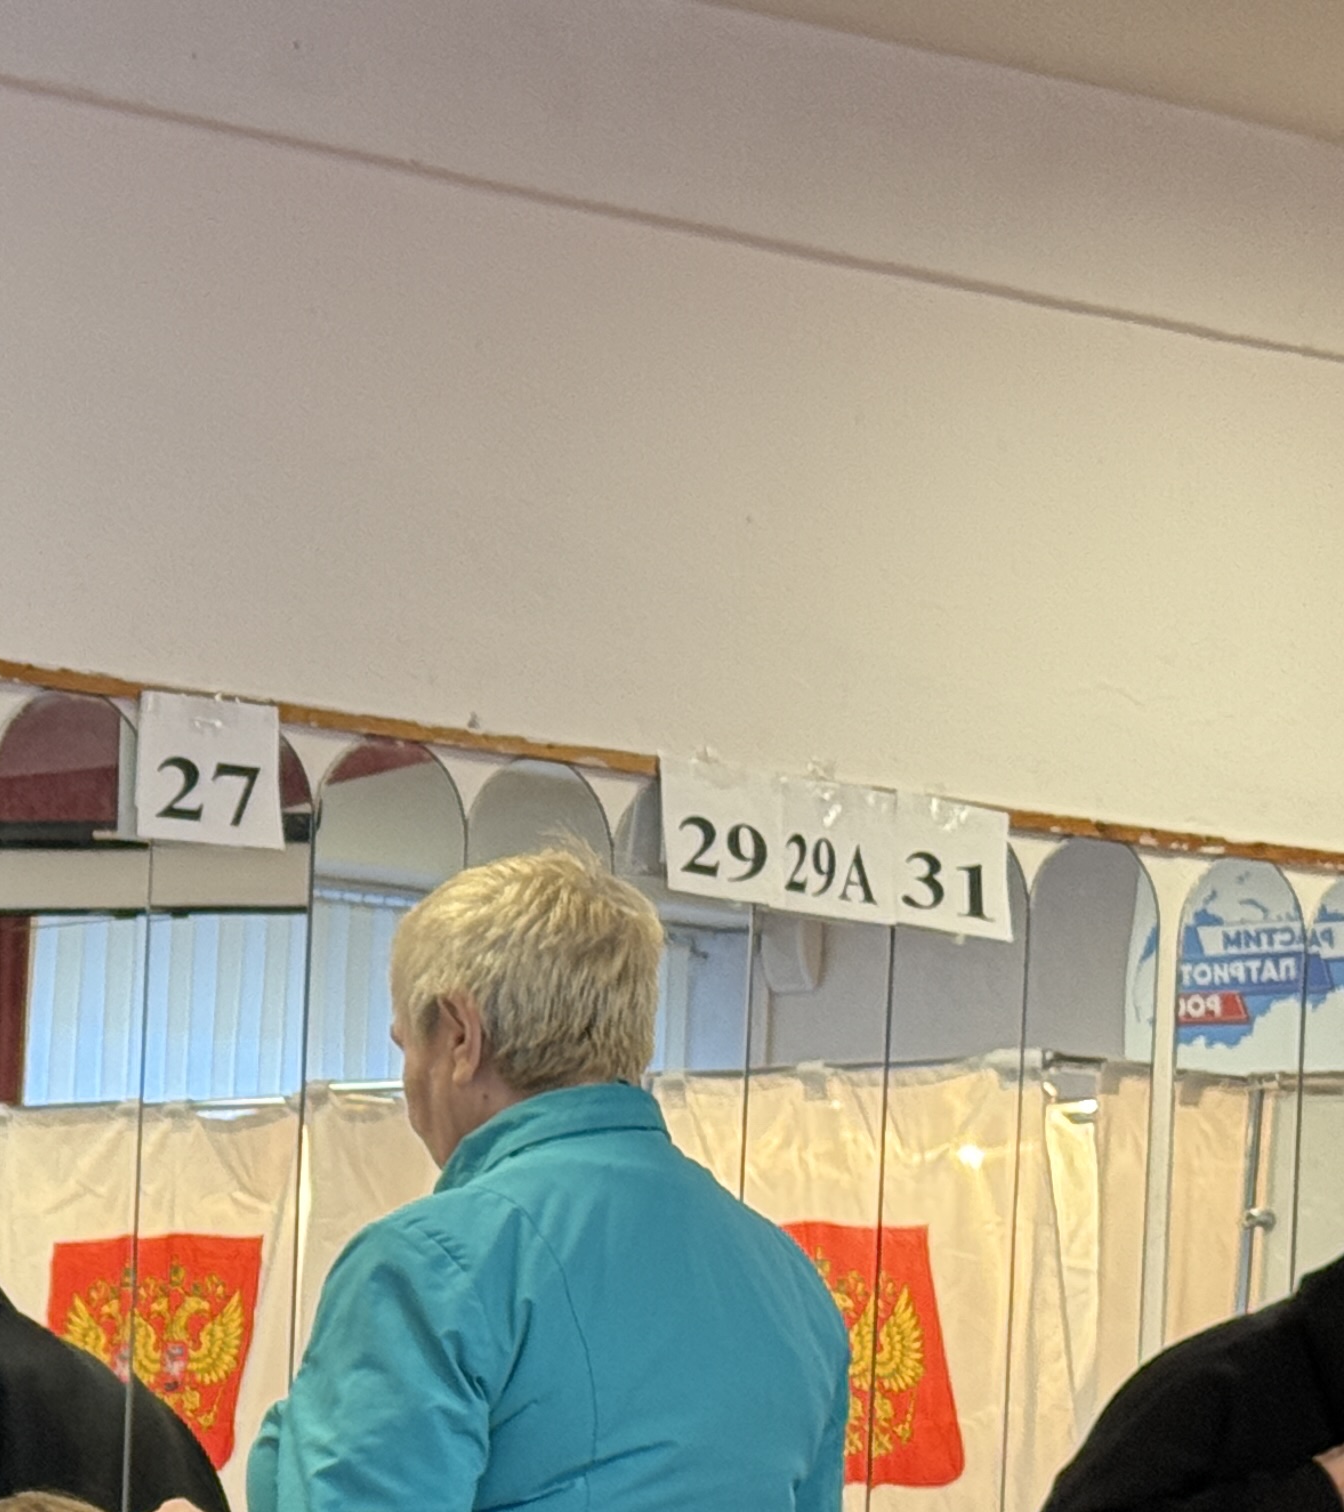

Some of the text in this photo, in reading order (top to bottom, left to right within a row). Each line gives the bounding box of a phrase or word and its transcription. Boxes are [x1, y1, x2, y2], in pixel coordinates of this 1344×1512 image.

[155, 756, 261, 828] 27
[678, 815, 769, 882] 29
[784, 833, 878, 906] 29А
[901, 851, 996, 923] 31
